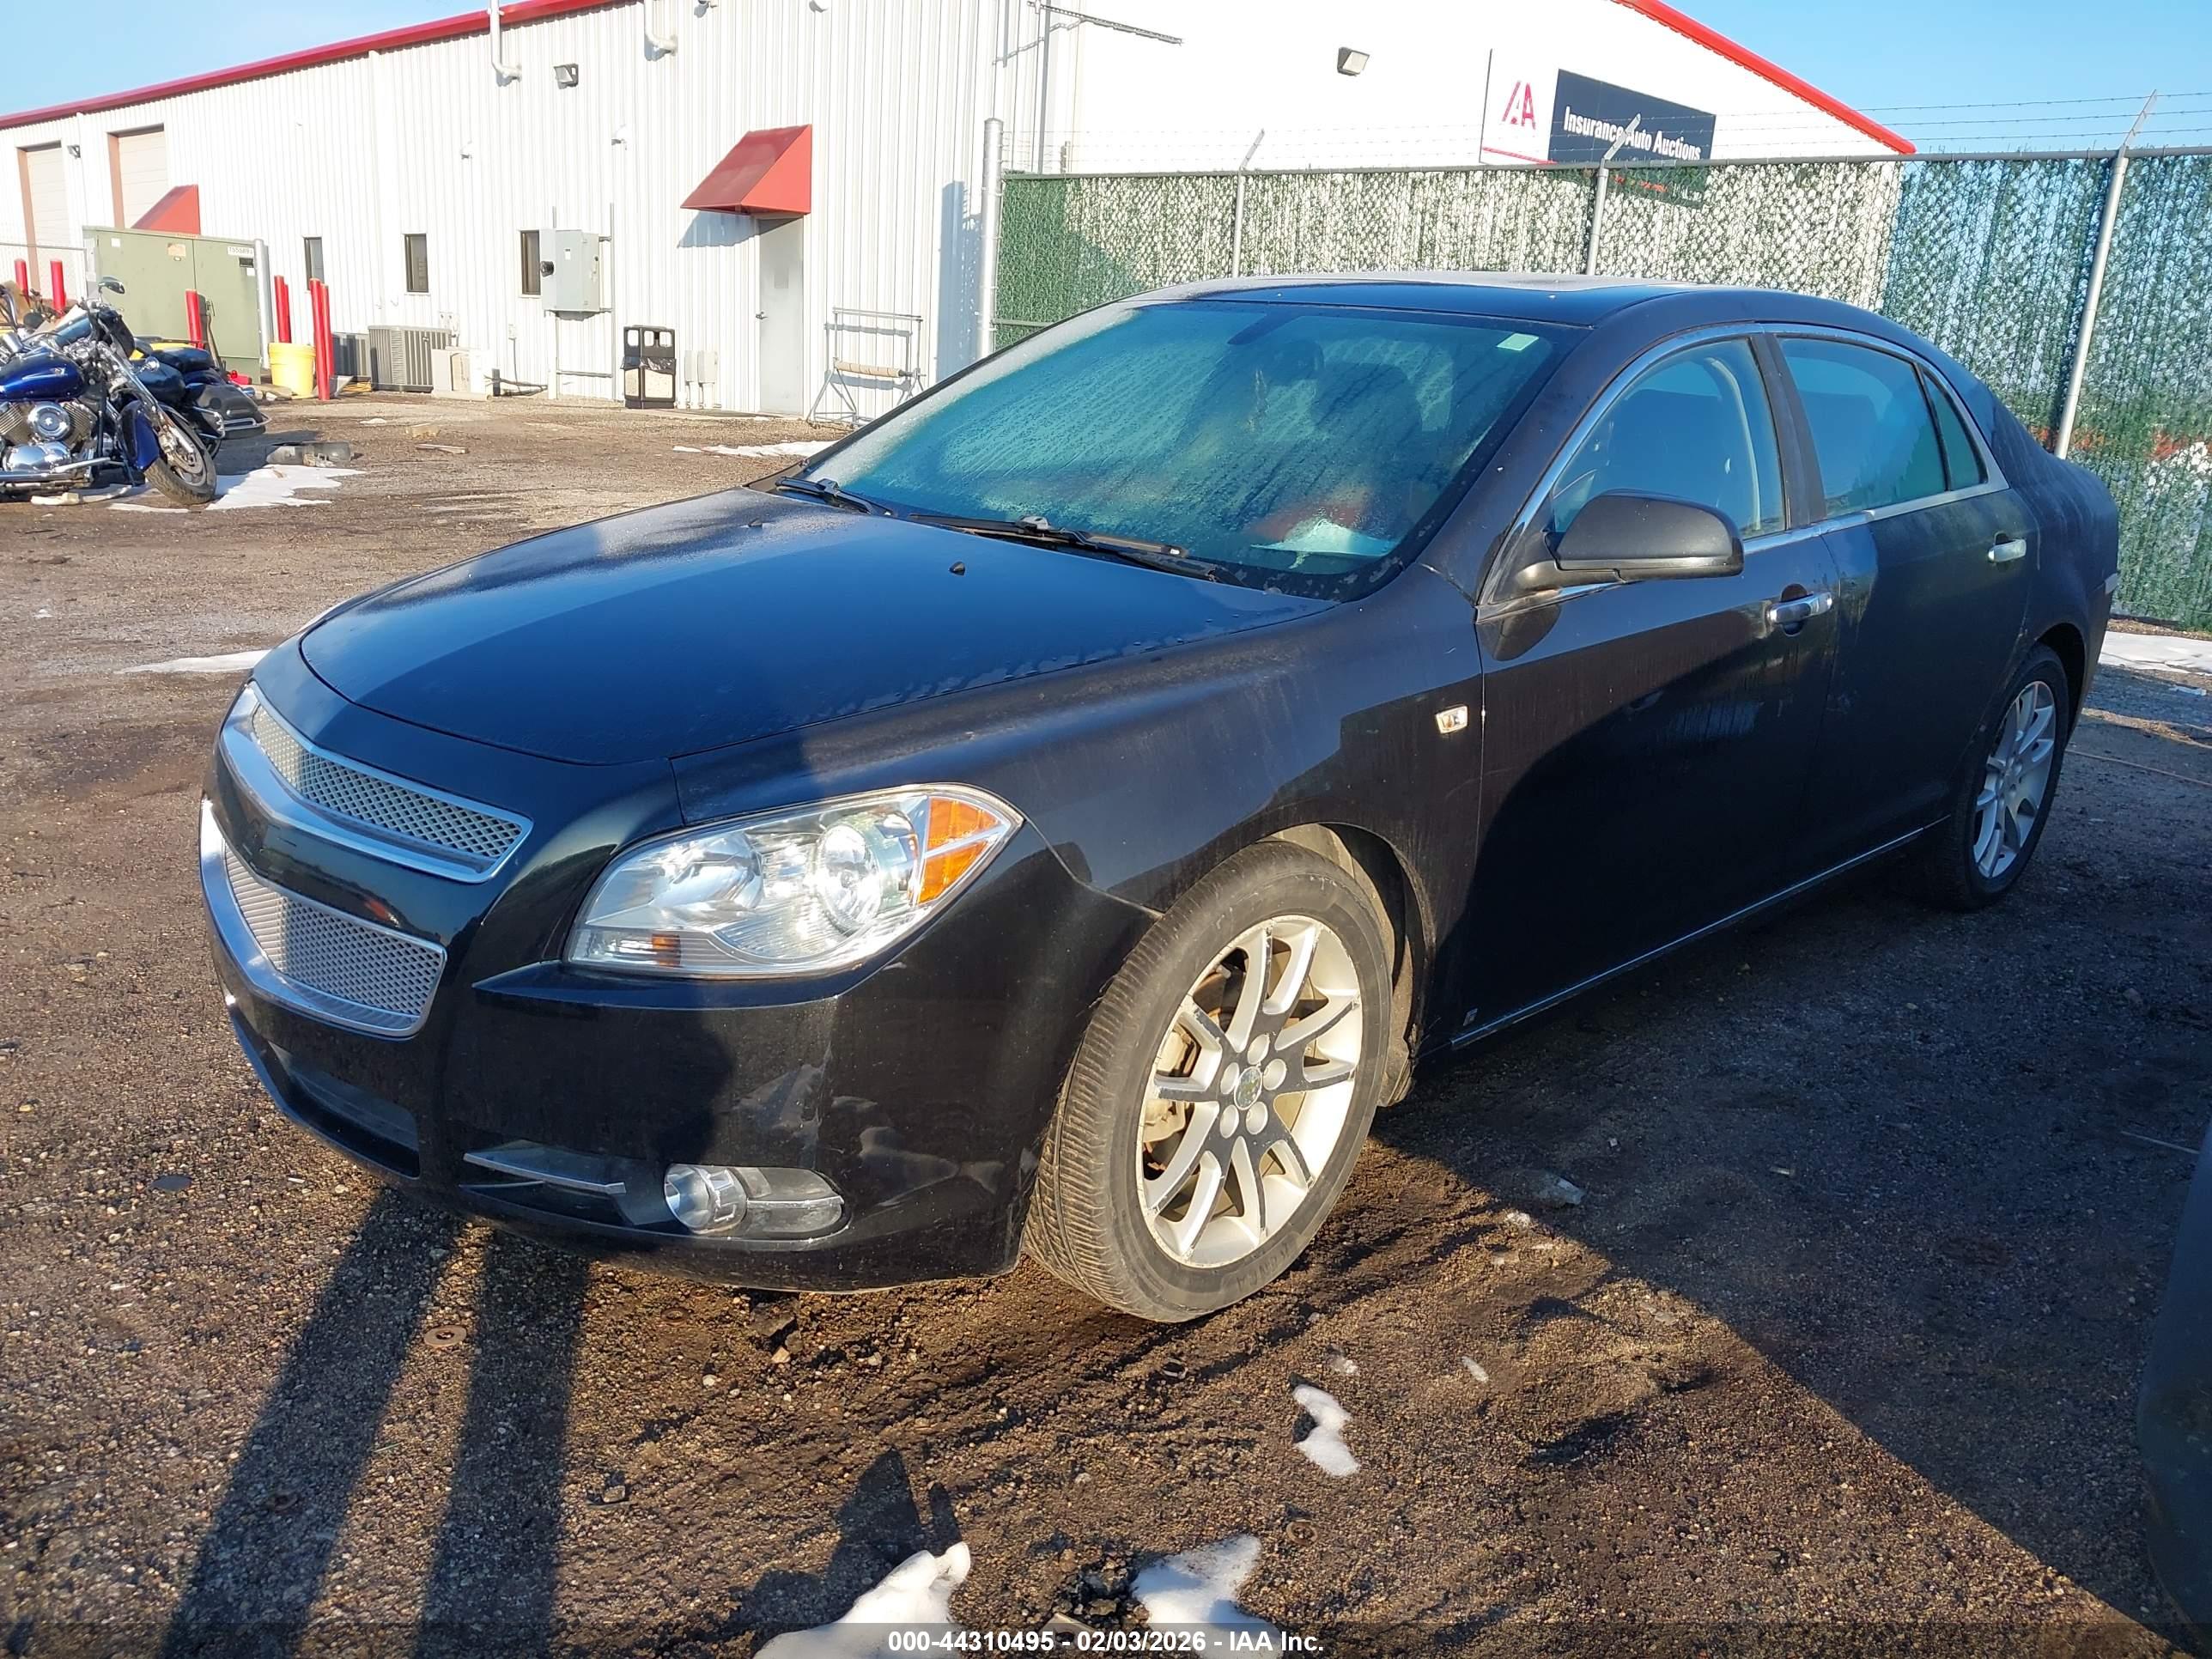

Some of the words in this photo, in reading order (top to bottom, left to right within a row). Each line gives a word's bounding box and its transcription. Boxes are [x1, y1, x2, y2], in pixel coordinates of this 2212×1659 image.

[1564, 106, 1624, 143] Insurance
[1626, 130, 1652, 150] Auto
[1653, 131, 1701, 161] Auctions
